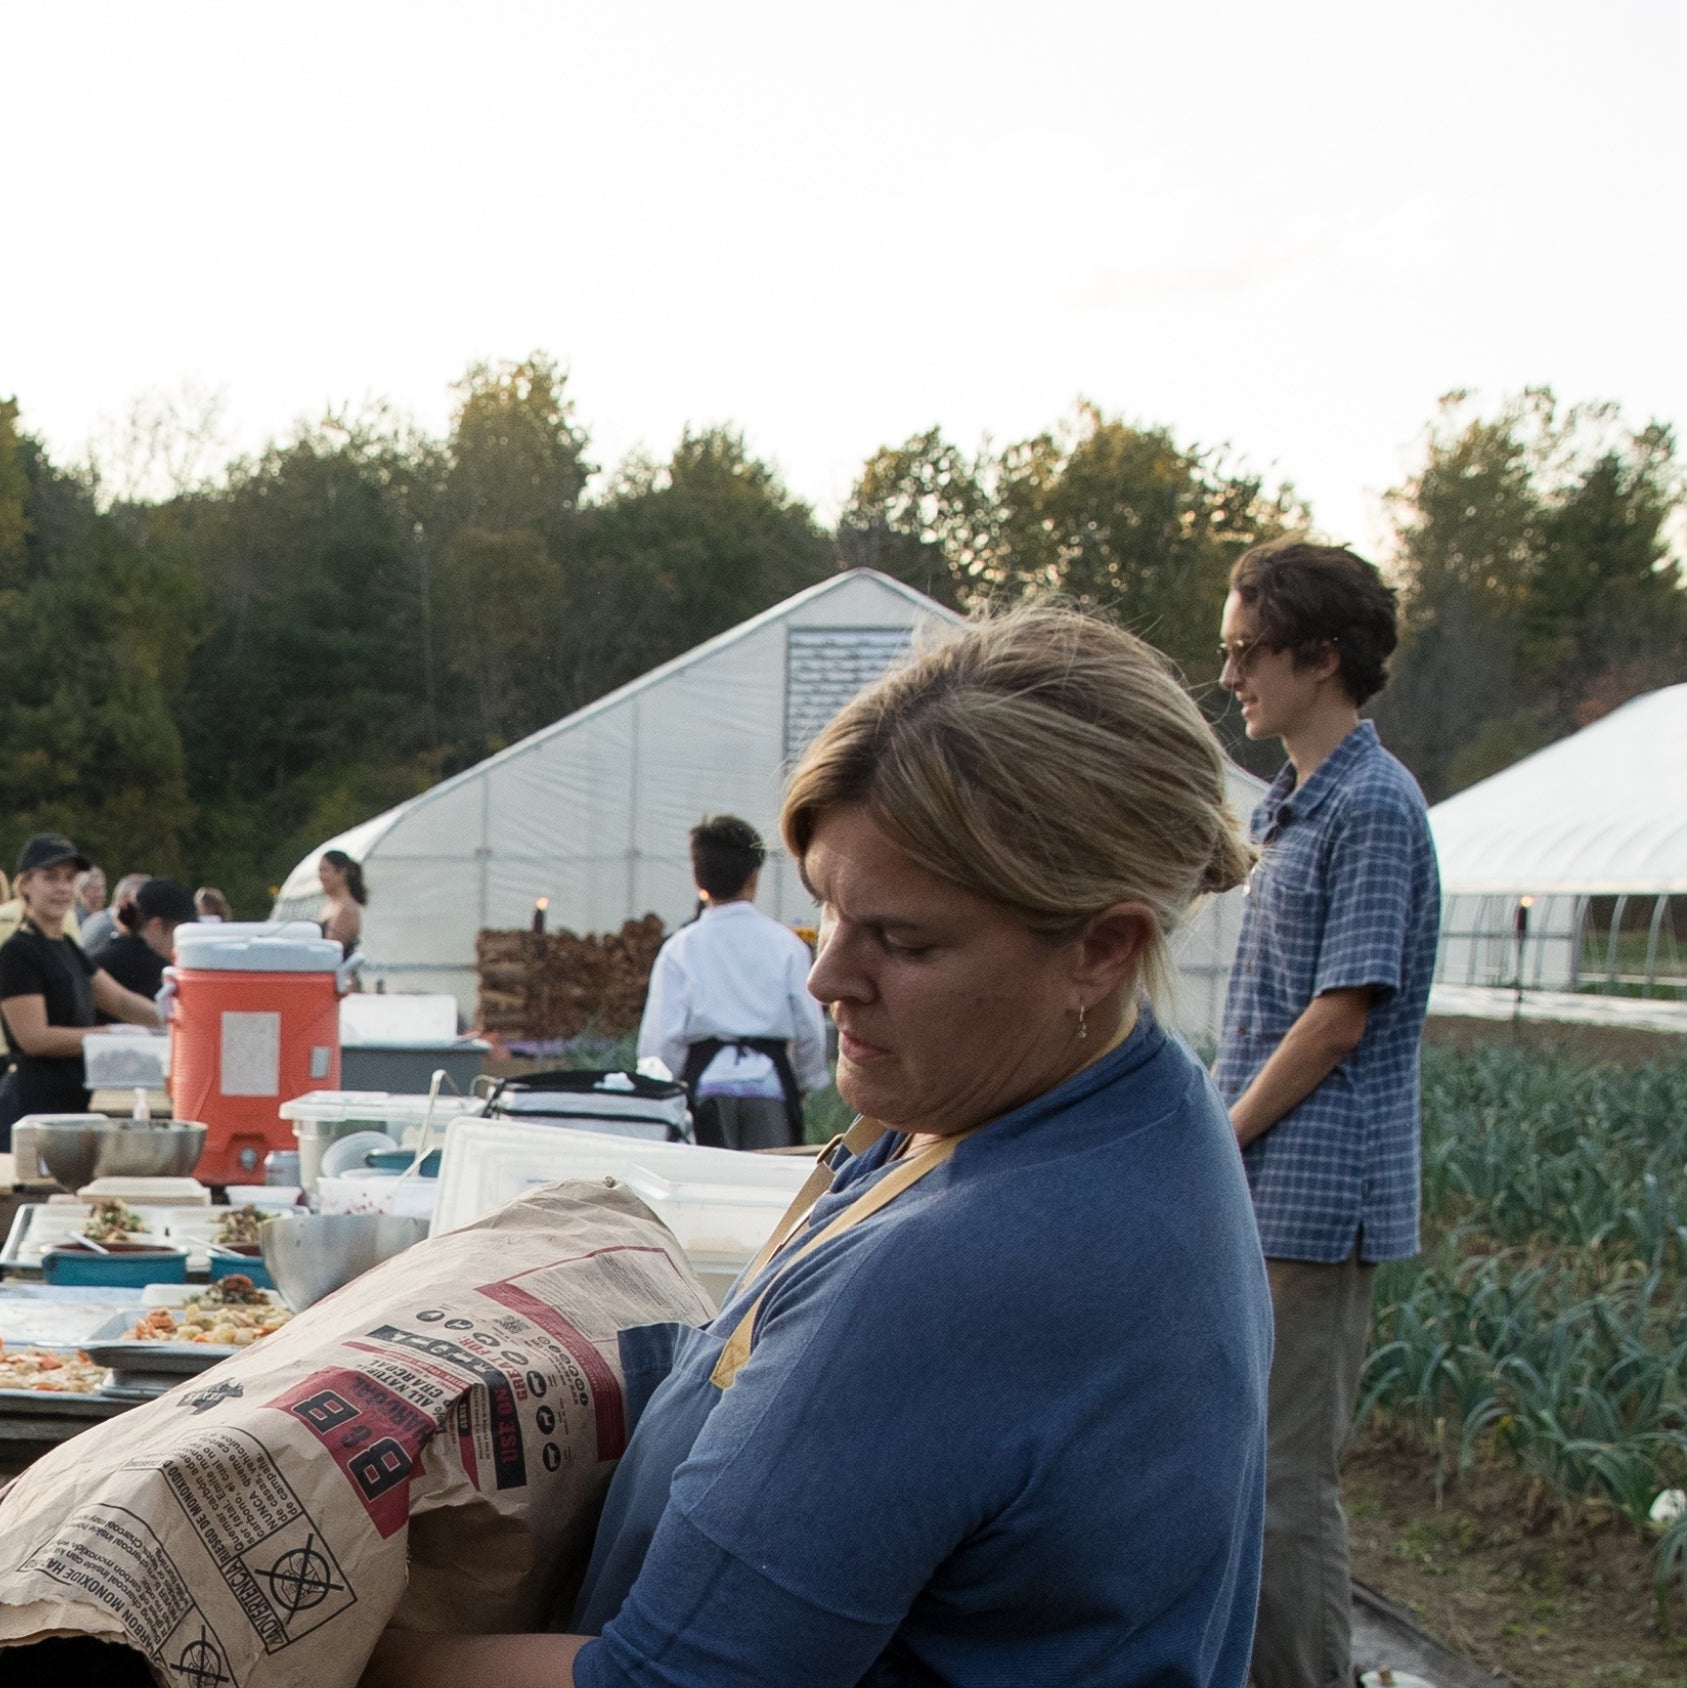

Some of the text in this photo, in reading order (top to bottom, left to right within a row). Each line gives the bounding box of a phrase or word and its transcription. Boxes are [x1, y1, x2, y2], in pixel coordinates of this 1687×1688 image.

[368, 1358, 444, 1401] CHARCOAL
[486, 1356, 529, 1401] GREAT
[405, 1388, 434, 1411] ALL
[494, 1386, 520, 1463] USE ON
[226, 1453, 253, 1488] queme
[254, 1451, 298, 1516] de campaña.
[165, 1464, 203, 1516] MONOXIDO
[193, 1475, 220, 1512] carbón
[202, 1445, 266, 1539] carbono, el cual no
[204, 1469, 255, 1545] ser fatal. Emite
[252, 1473, 279, 1508] casas,
[195, 1513, 210, 1529] DE
[247, 1490, 278, 1531] NUNCA
[274, 1507, 288, 1523] de
[104, 1520, 143, 1549] Charcoal
[203, 1526, 231, 1563] RIESGO
[214, 1511, 245, 1553] Quemar
[111, 1537, 149, 1568] charcoal
[61, 1568, 125, 1611] MONOXIDE
[64, 1550, 162, 1645] Burning charcoal inside can
[111, 1565, 142, 1593] carbon
[138, 1591, 151, 1605] off
[153, 1599, 163, 1613] no
[221, 1559, 284, 1642] ADVERTENCIA
[159, 1626, 167, 1638] It
